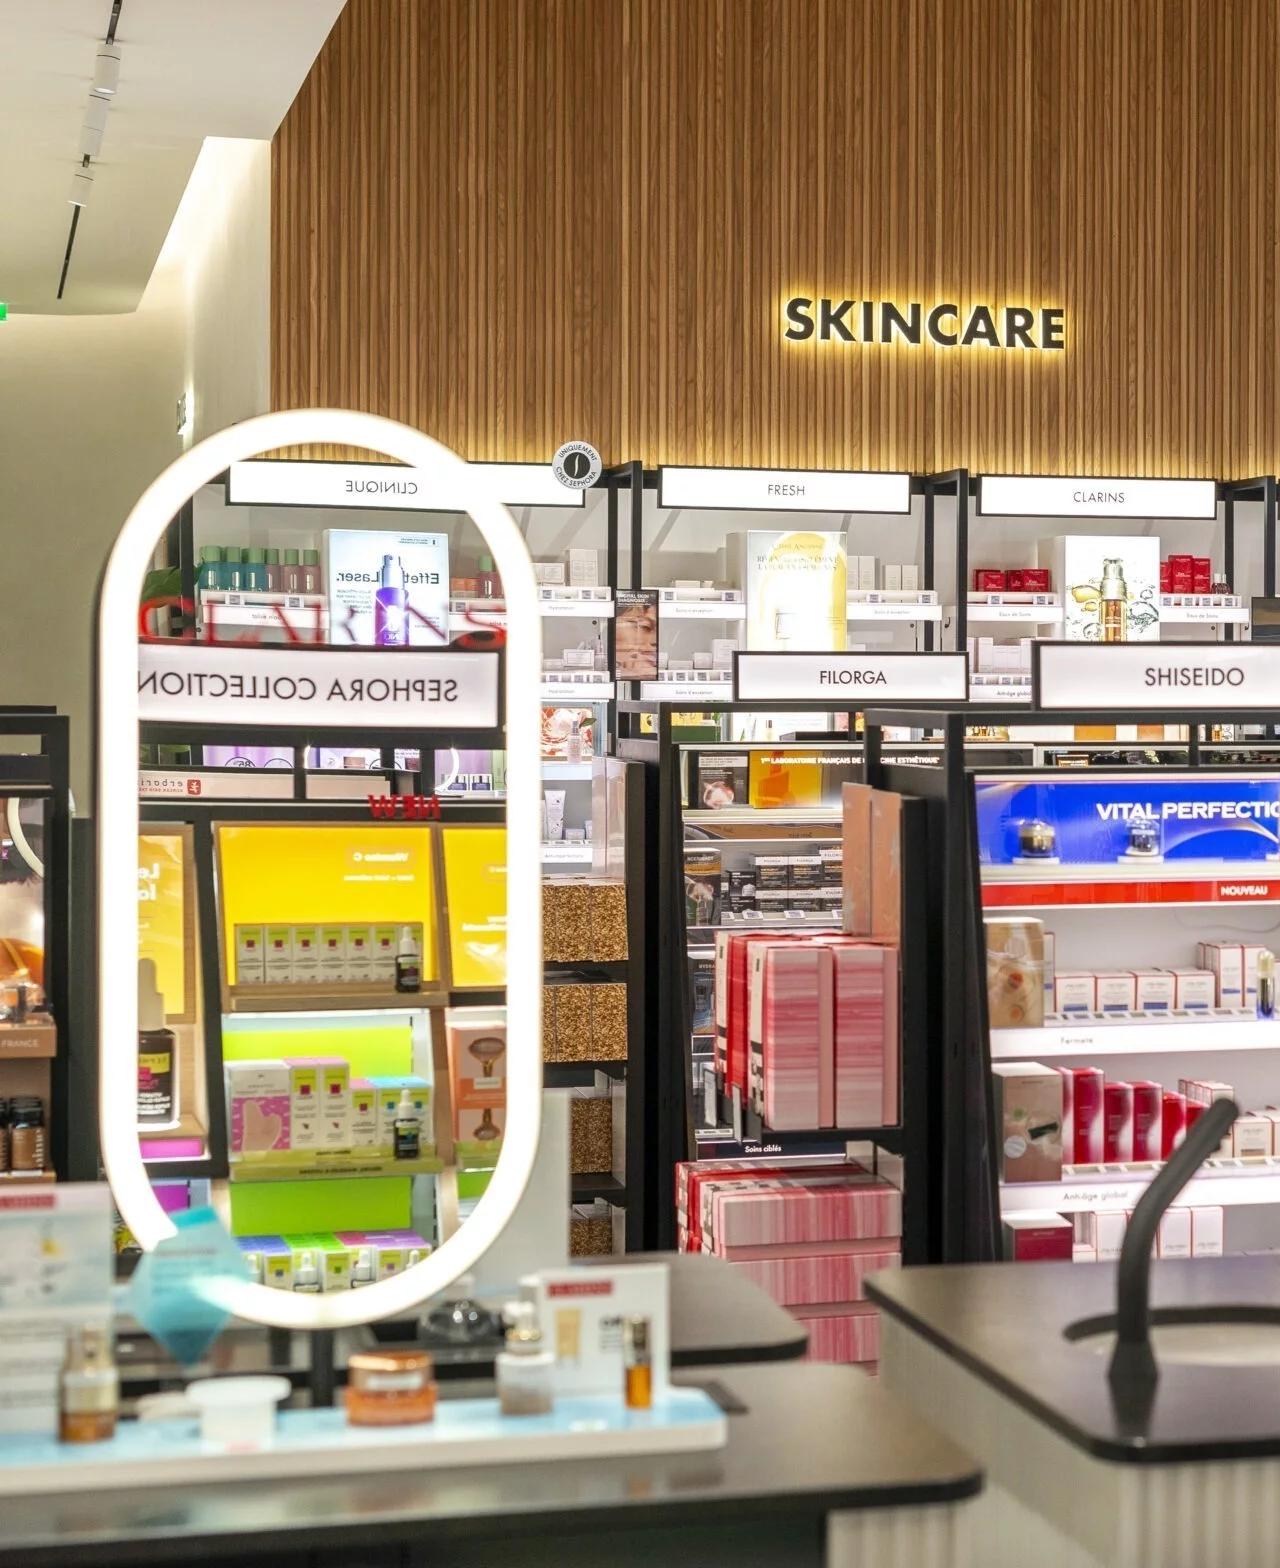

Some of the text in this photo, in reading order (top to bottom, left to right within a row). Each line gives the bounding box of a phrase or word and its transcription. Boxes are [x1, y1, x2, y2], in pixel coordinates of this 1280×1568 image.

[784, 297, 1065, 350] SKINCARE
[558, 444, 598, 461] UNIQUEMENT
[556, 466, 597, 487] CHEZ SEPHORA
[766, 483, 806, 497] FRESH
[1072, 490, 1126, 504] CLARINS
[819, 670, 888, 685] FILORGA
[1144, 667, 1246, 688] SHISEIDO
[817, 757, 850, 765] FRANÇAIS
[1096, 802, 1161, 820] VITAL
[1220, 885, 1268, 896] NOUVEAU
[1, 1039, 40, 1048] FRANCE
[744, 1144, 782, 1154] Soins ciblés
